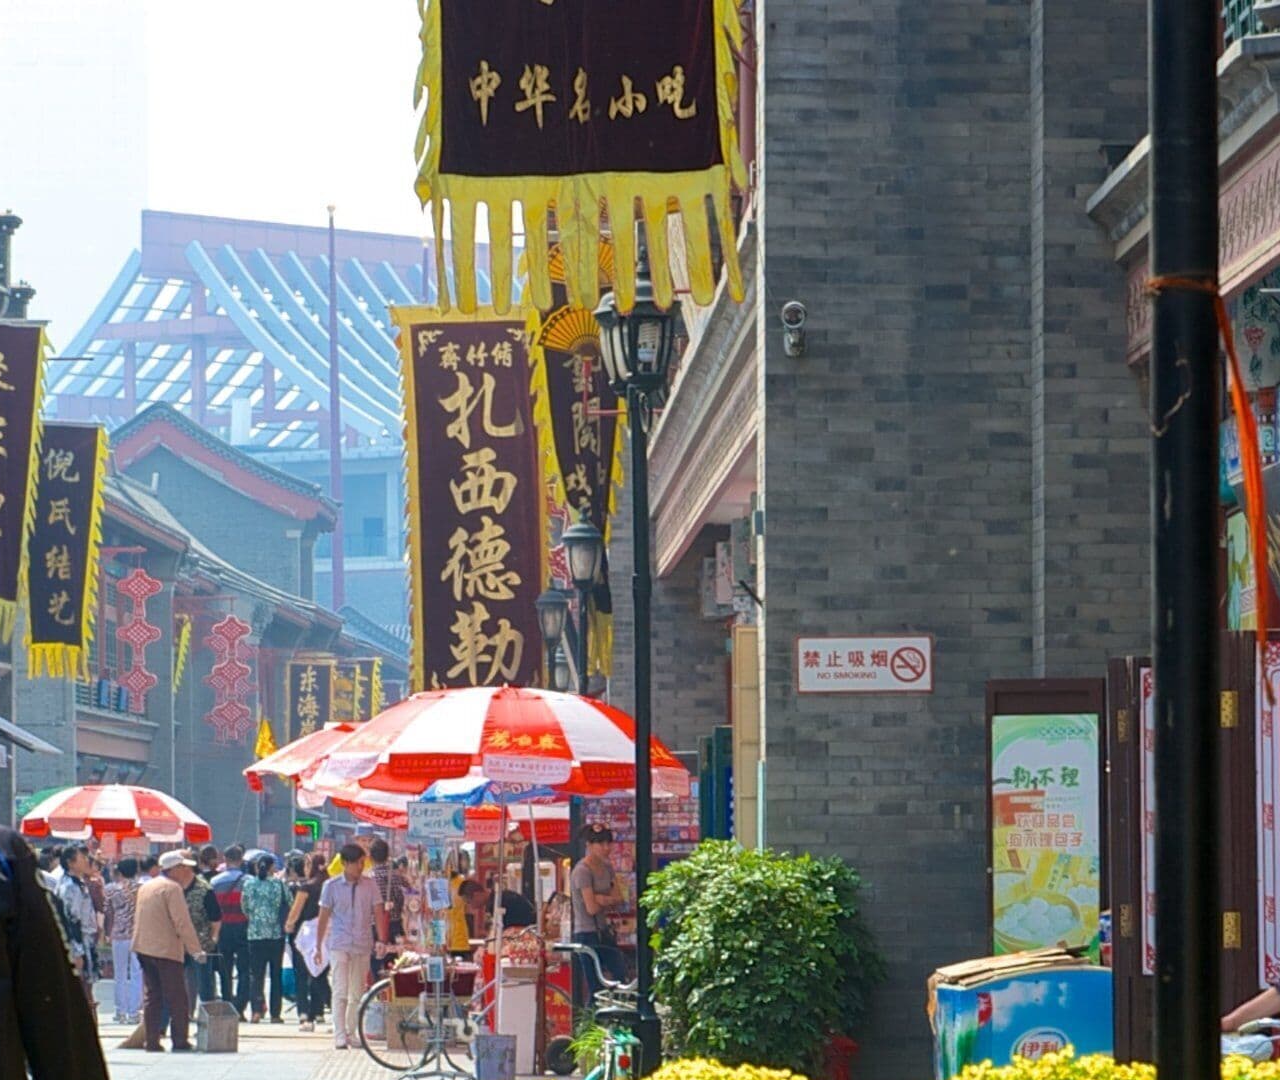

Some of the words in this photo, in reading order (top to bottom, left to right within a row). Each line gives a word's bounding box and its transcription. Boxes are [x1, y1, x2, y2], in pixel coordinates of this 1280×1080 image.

[470, 60, 697, 130] 中华名小吃
[438, 371, 525, 687] 扎西德勒
[803, 650, 888, 668] 禁止吸烟
[817, 672, 832, 680] NO
[833, 672, 877, 680] SMOKING
[1013, 765, 1080, 789] 狗不理
